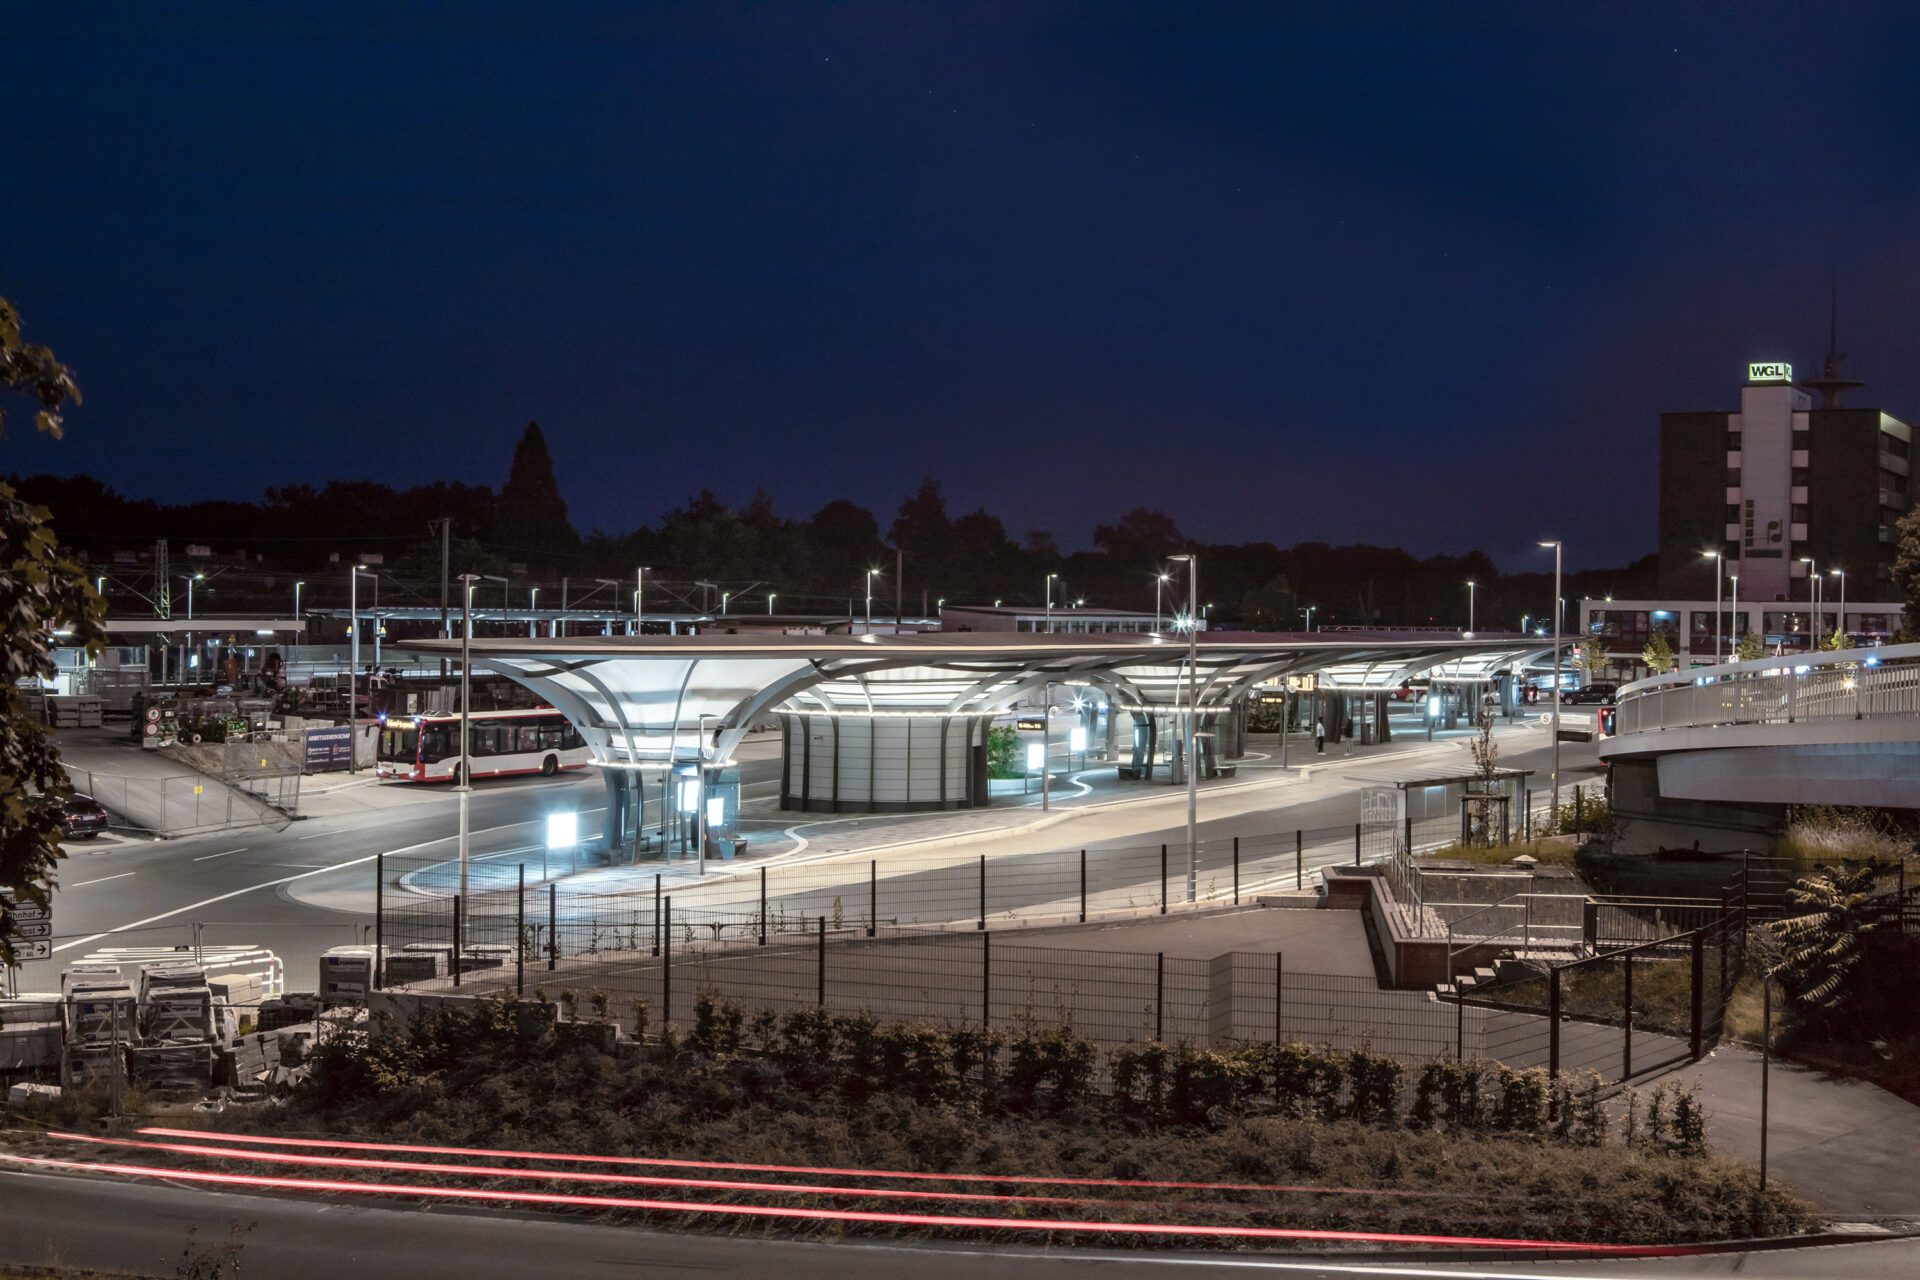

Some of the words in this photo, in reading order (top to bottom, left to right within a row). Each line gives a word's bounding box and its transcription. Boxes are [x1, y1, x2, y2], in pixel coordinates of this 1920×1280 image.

[1752, 366, 1783, 377] WGL
[309, 733, 351, 741] ARBEITSGEMEINSCHAF
[704, 749, 712, 757] 10
